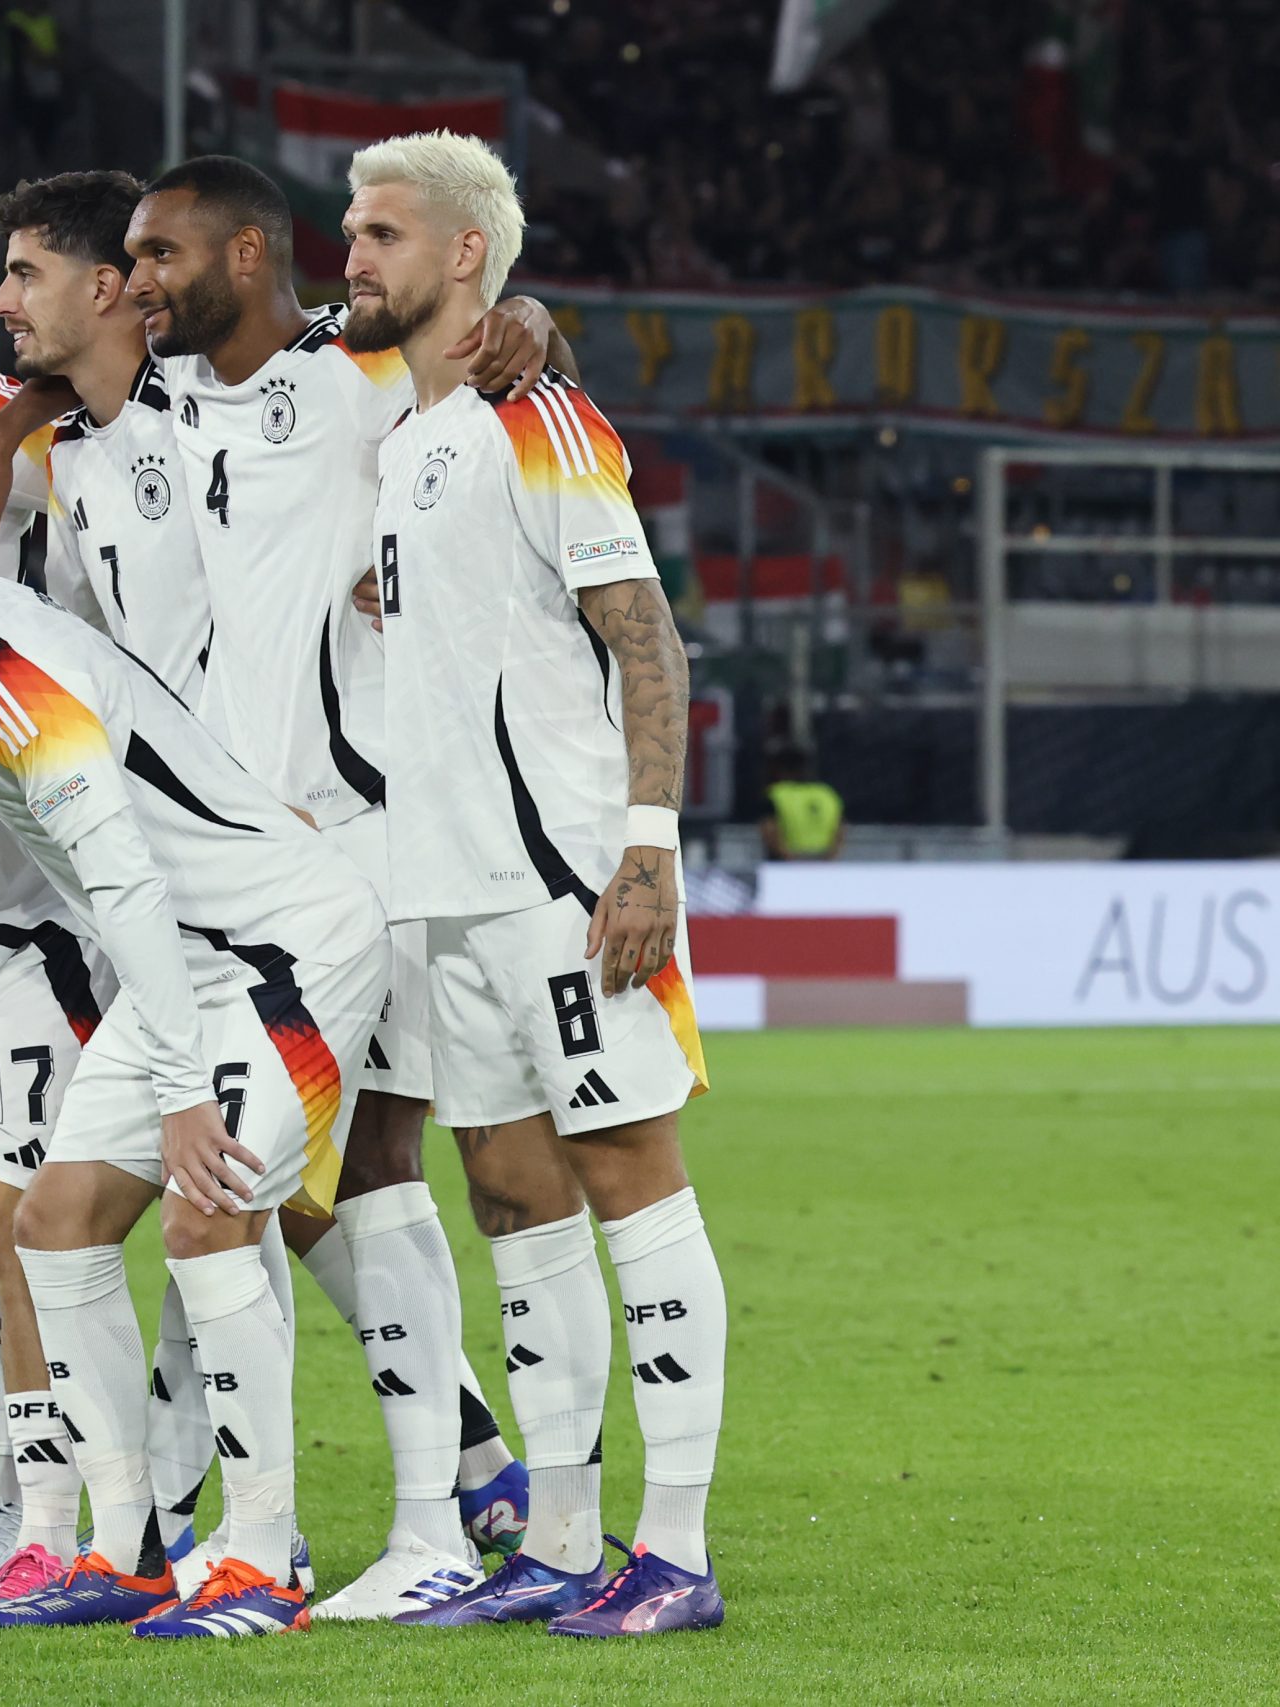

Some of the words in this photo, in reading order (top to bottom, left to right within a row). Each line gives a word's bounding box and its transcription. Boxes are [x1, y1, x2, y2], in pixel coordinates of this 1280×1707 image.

[205, 448, 231, 529] 4
[99, 544, 128, 624] 7
[381, 533, 402, 618] 8
[568, 539, 638, 560] FOUNDATION
[32, 775, 87, 817] FOUNDATION
[1073, 887, 1272, 1005] AUS
[547, 970, 605, 1060] 8
[360, 1323, 408, 1346] FB
[623, 1299, 688, 1325] DFB
